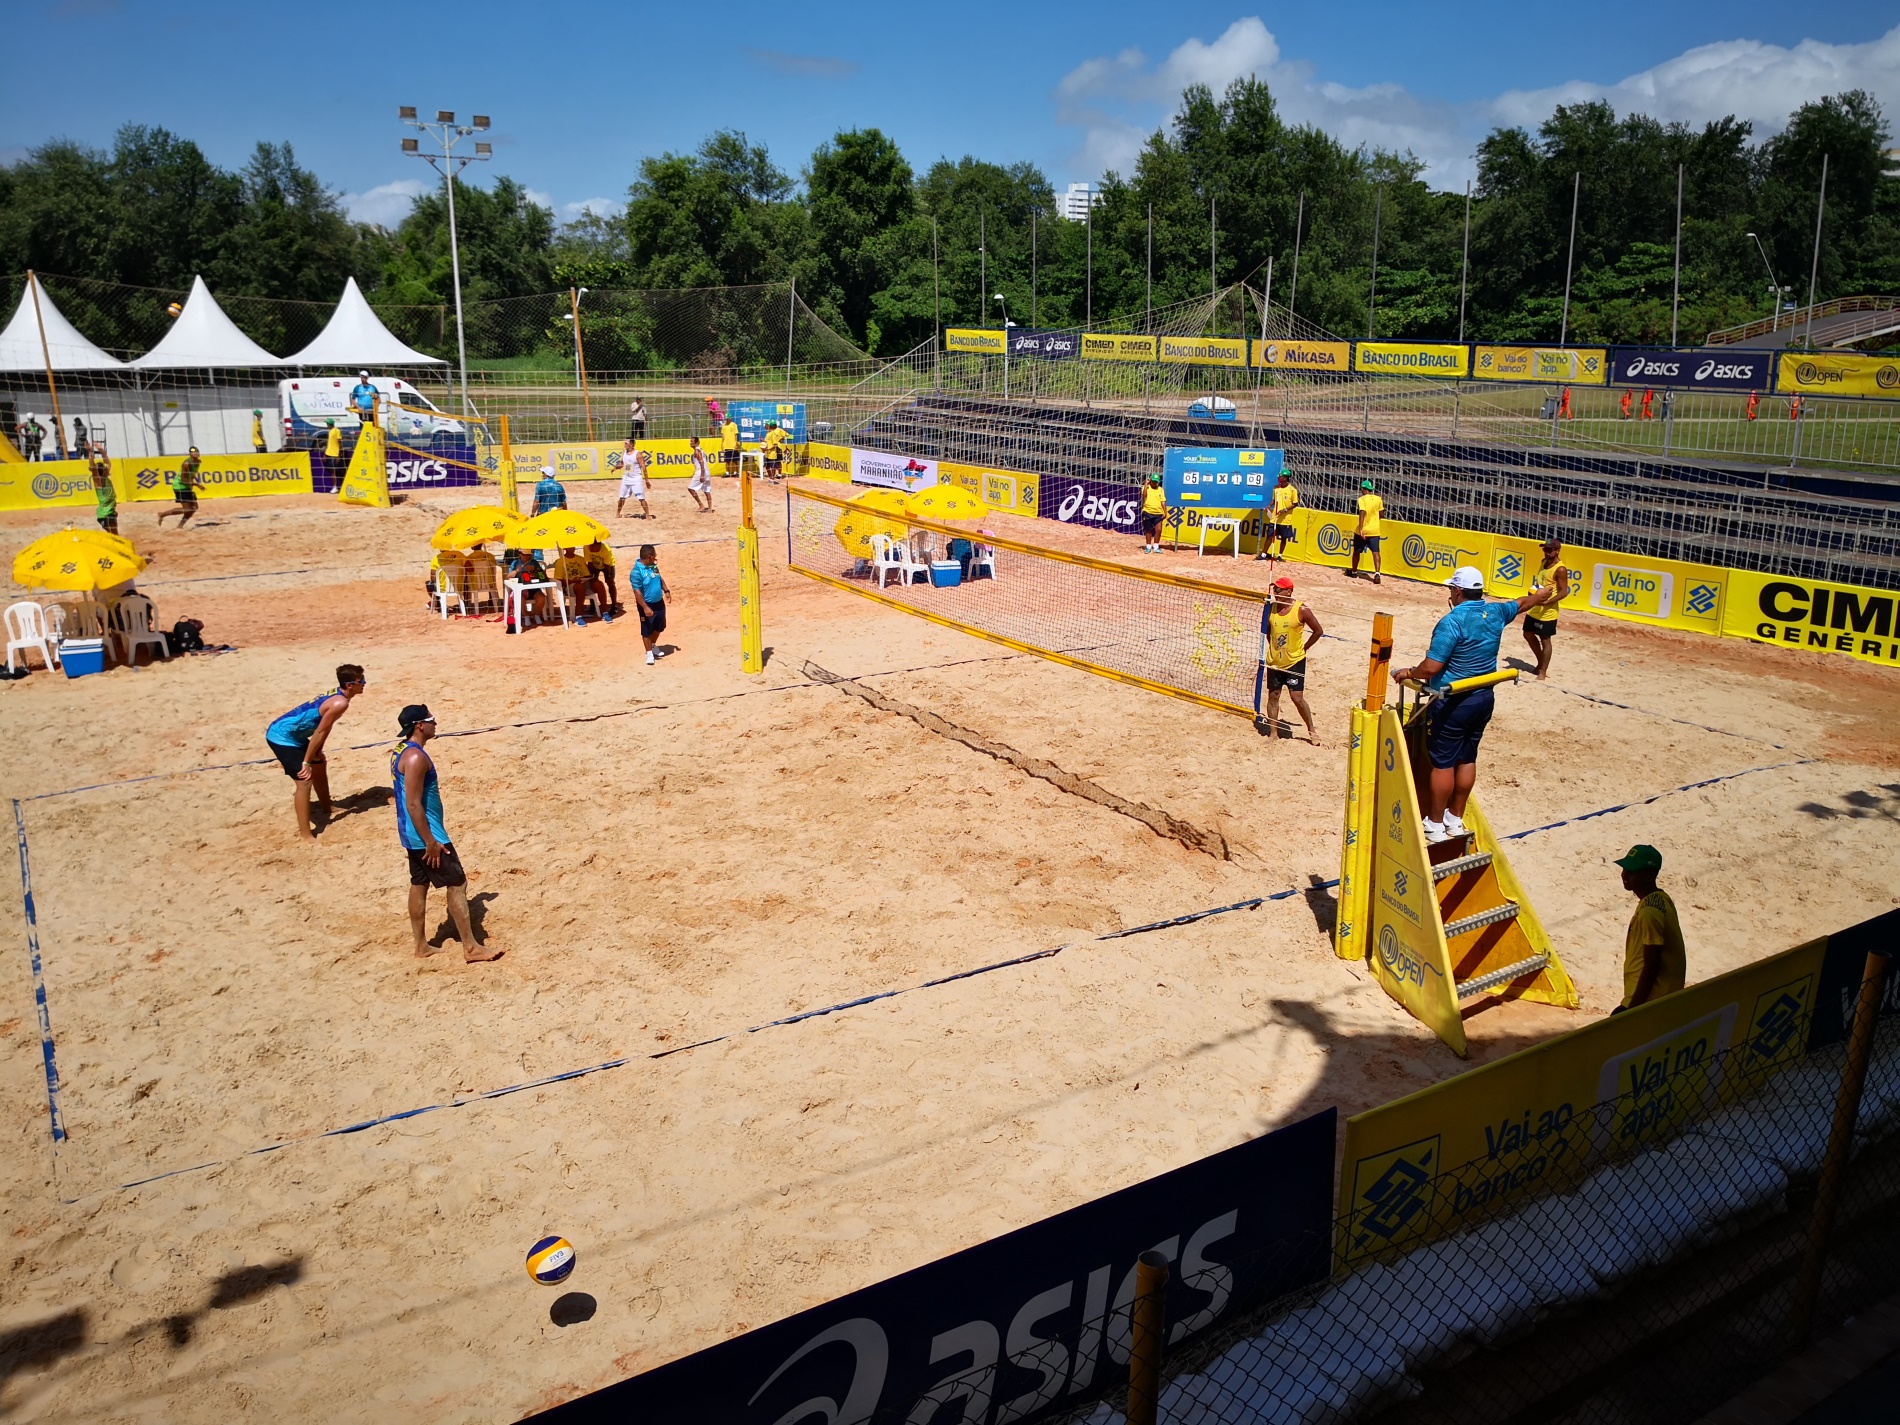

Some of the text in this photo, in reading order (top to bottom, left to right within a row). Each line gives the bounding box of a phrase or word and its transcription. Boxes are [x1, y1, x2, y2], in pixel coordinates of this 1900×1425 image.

[950, 334, 1001, 348] BANCO DO BRASIL
[1085, 339, 1115, 349] CIMED
[1120, 341, 1152, 350] CIMED
[1165, 343, 1240, 359] BANCO DO BRASIL
[1541, 352, 1568, 364] Vai no
[1362, 350, 1459, 368] BANCO DO BRASIL
[1504, 354, 1516, 363] Vai
[1497, 363, 1527, 373] banco?
[1540, 365, 1559, 375] app.
[1817, 372, 1843, 382] OPEN
[365, 432, 372, 442] 5
[514, 454, 542, 463] Vai ao
[558, 452, 588, 463] Vai no
[815, 457, 825, 468] DO
[825, 456, 850, 473] BRASIL
[860, 460, 892, 469] GOVERNO
[559, 463, 580, 473] app.
[163, 467, 304, 485] BNCO DO BRASIL
[1218, 474, 1226, 483] X
[60, 479, 92, 493] OPEN
[988, 477, 1009, 491] Vai no
[988, 490, 1002, 501] app.
[1425, 550, 1457, 568] OPEN
[1609, 571, 1656, 592] Vai no
[1606, 589, 1638, 607] app.
[1758, 581, 1900, 639] CIM
[1384, 737, 1395, 772] 3
[1381, 889, 1420, 924] BANCO DO BRASIL
[1397, 952, 1425, 988] OPEN
[1630, 1038, 1707, 1099] Vai no
[1485, 1102, 1574, 1161] Vai ao
[548, 1250, 564, 1263] FIVB
